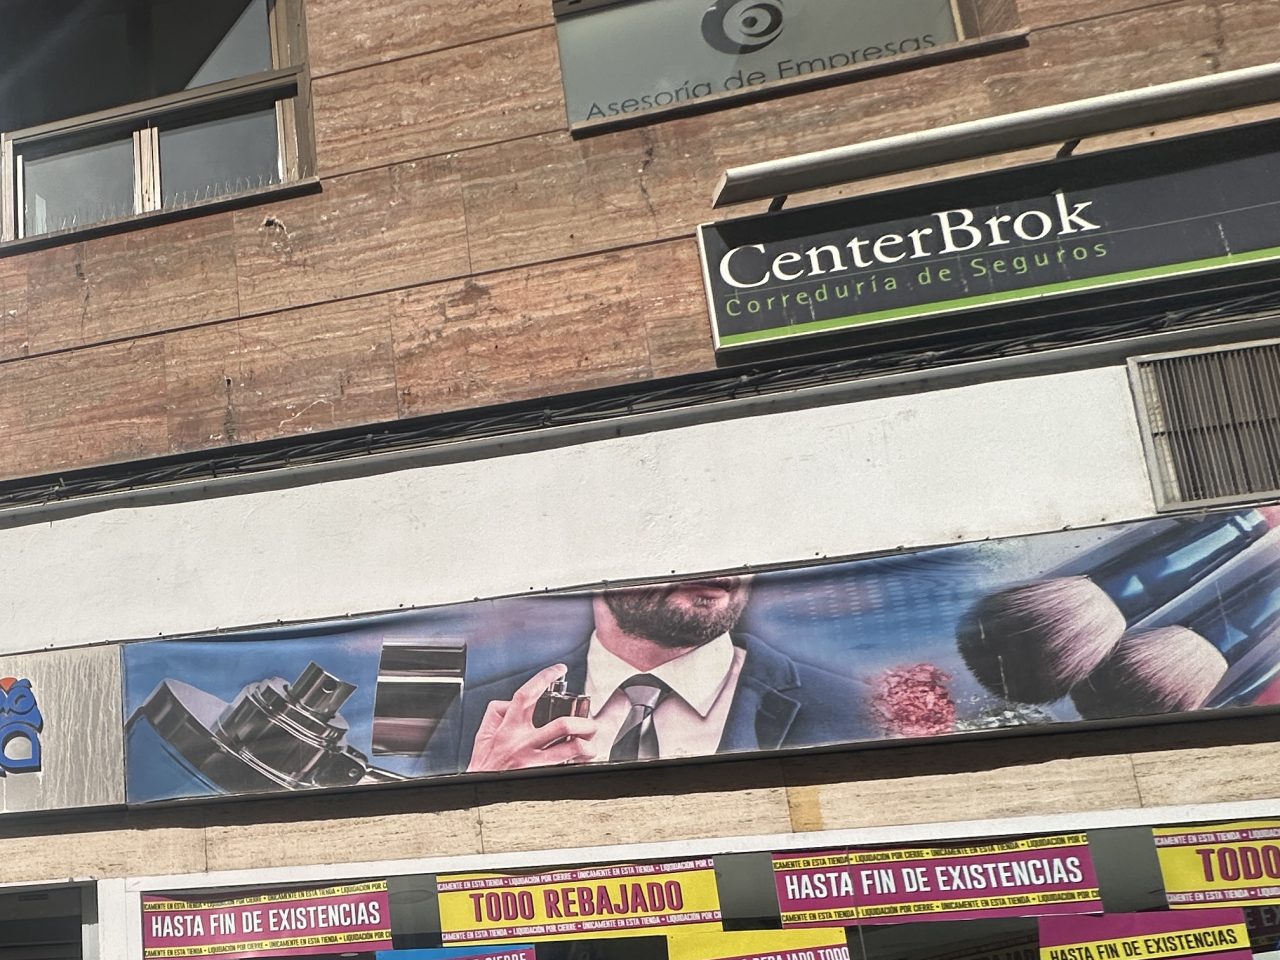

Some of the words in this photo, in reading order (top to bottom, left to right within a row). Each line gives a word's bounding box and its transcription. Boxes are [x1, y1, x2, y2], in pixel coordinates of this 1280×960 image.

[584, 80, 713, 121] Asesoría
[723, 70, 767, 93] de
[778, 32, 936, 81] Empresas
[719, 190, 1101, 288] CenterBrok
[725, 273, 898, 316] Correduría
[919, 263, 952, 286] de
[972, 240, 1108, 277] Seguros
[785, 872, 855, 900] HASTA
[860, 868, 896, 895] FIN
[902, 866, 931, 893] DE
[935, 856, 1083, 891] EXISTENCIAS
[1196, 845, 1280, 882] TODO
[152, 914, 204, 938] HASTA
[211, 912, 236, 935] FIN
[242, 911, 263, 933] DE
[269, 901, 380, 932] EXISTENCIAS
[469, 891, 535, 922] TODO
[543, 880, 684, 918] REBAJADO
[1097, 944, 1119, 960] FIN
[1124, 940, 1141, 957] DE
[1146, 928, 1237, 953] EXISTENCIAS
